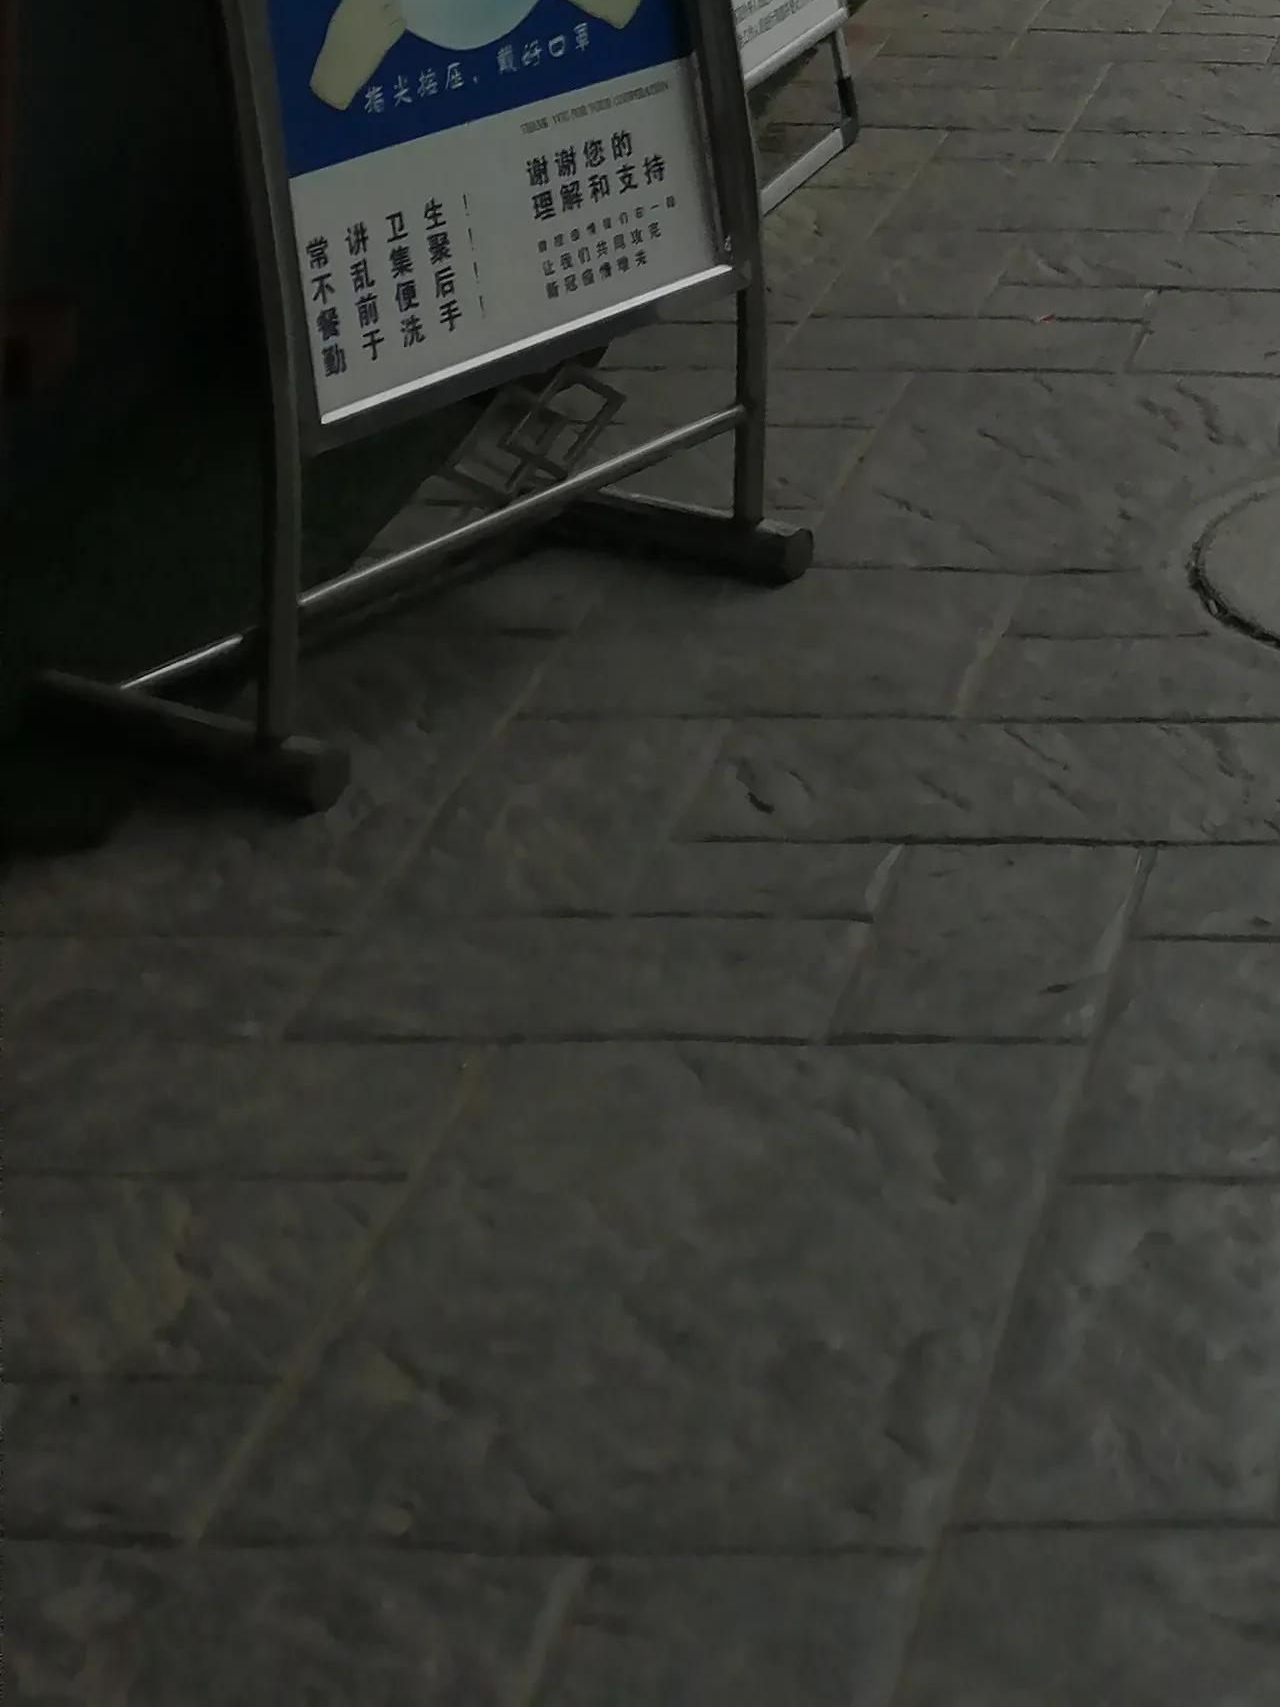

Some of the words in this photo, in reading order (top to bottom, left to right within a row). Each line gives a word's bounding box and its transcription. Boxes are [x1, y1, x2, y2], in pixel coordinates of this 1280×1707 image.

[526, 130, 633, 187] 谢谢您的
[532, 154, 665, 222] 理解和支持
[542, 221, 662, 277] 让我们共同攻克
